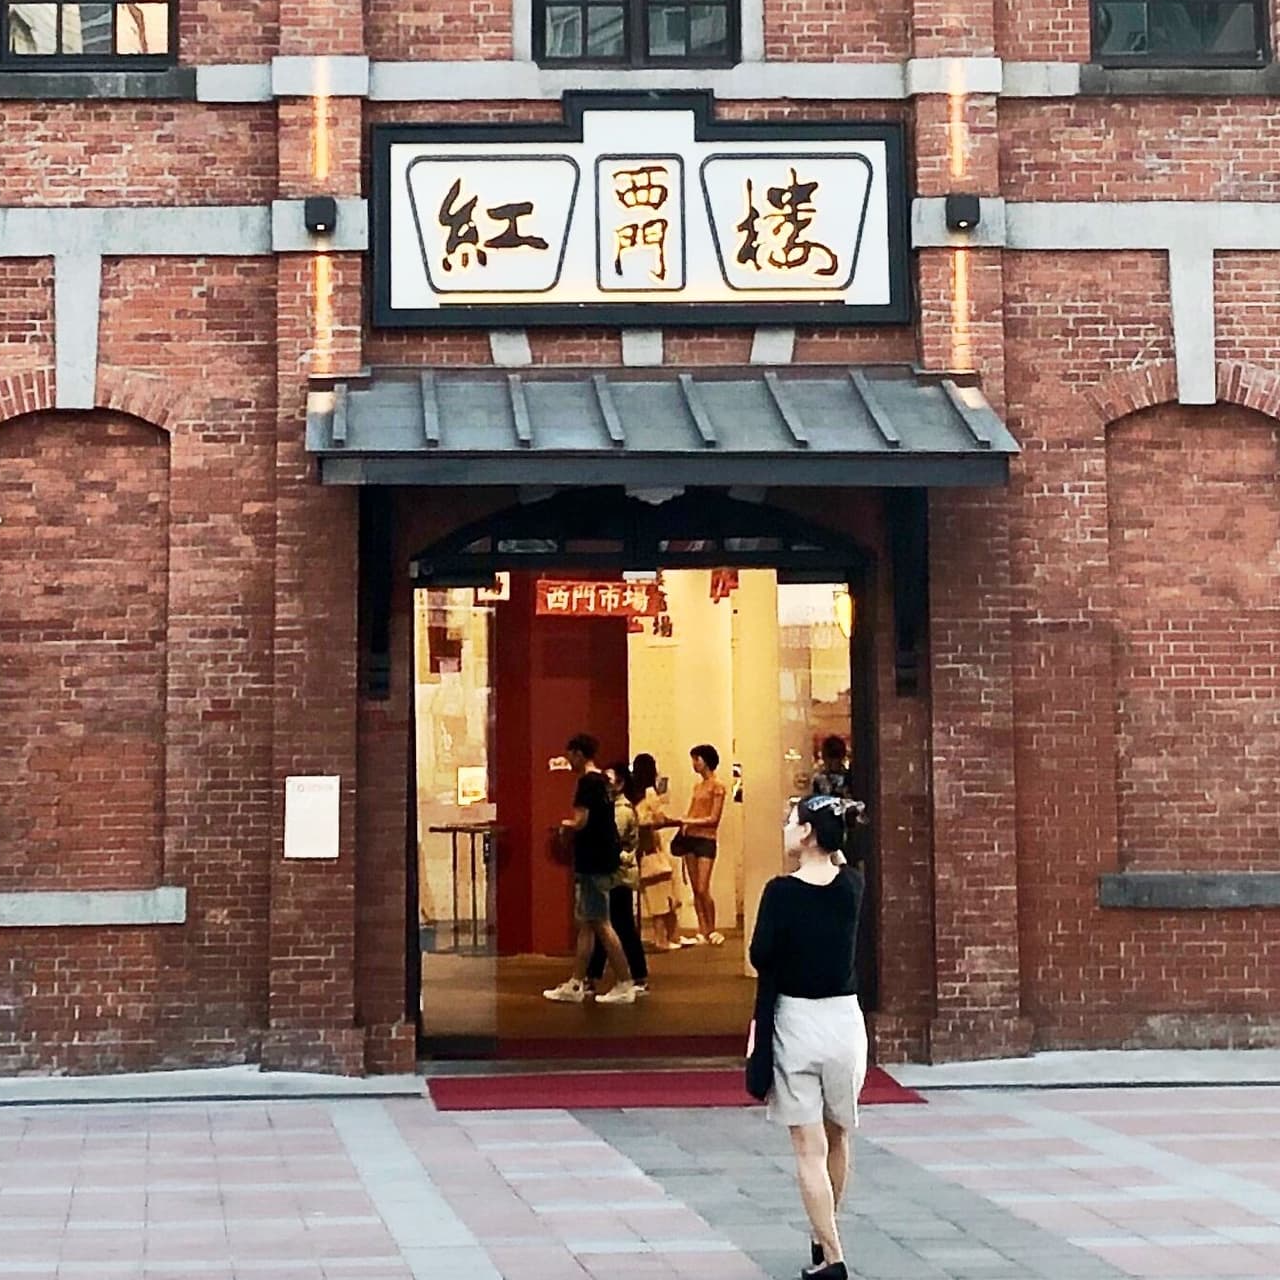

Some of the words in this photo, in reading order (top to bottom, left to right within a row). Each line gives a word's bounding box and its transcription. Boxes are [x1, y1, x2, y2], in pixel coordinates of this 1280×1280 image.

[438, 177, 549, 273] 紅
[612, 165, 670, 281] 西門
[546, 582, 650, 613] 西門市場
